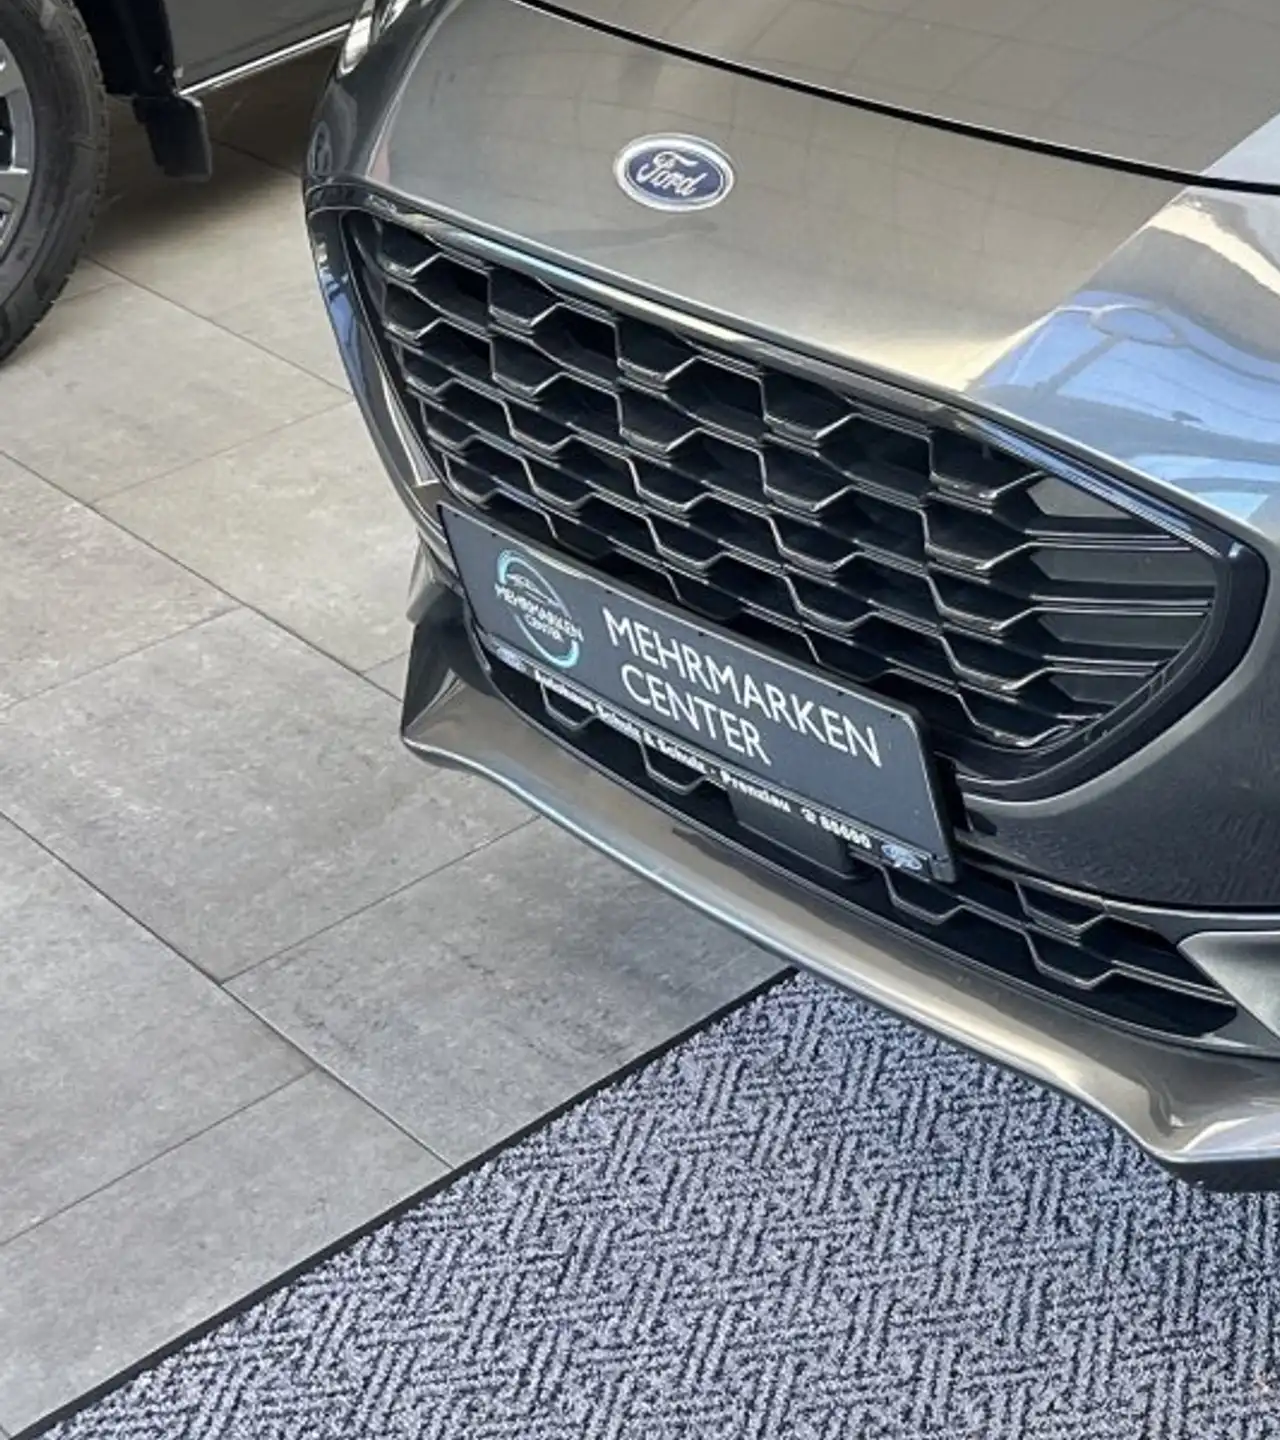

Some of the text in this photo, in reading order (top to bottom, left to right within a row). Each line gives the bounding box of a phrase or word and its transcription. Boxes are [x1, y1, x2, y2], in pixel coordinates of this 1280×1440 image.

[635, 151, 708, 196] Ford
[602, 606, 882, 768] MEHRMARKEN
[621, 664, 772, 766] CENTER
